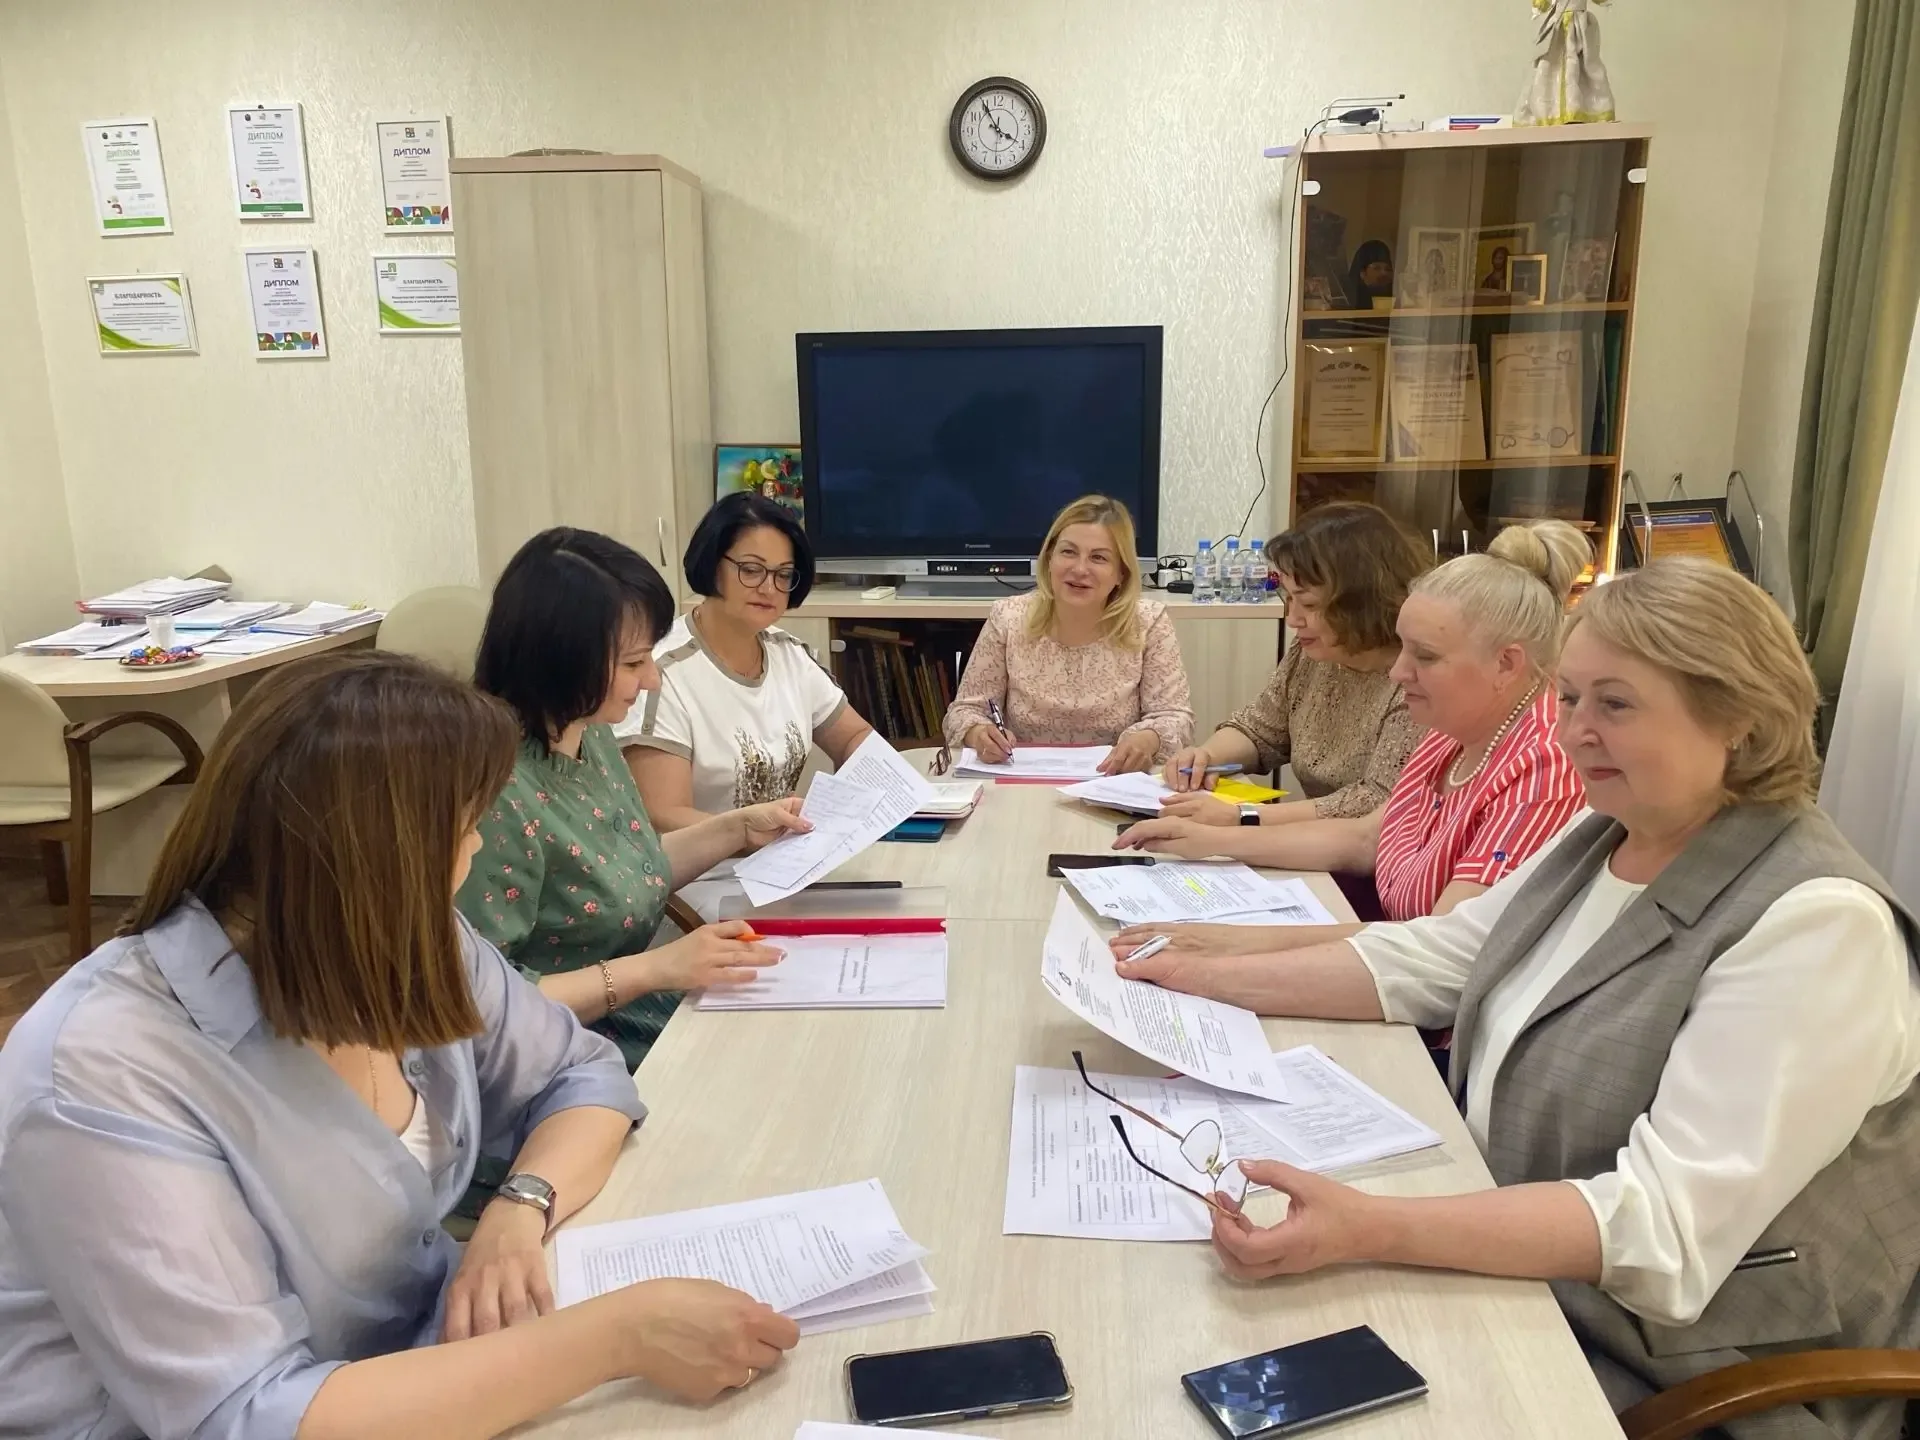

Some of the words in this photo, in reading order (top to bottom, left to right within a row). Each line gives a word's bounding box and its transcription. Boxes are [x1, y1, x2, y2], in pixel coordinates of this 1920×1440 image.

[966, 126, 974, 137] 9
[1023, 124, 1031, 136] 3
[247, 132, 284, 142] ДИПЛОМ
[971, 140, 978, 152] 8
[1018, 139, 1025, 151] 4
[106, 149, 141, 160] ДИПЛОМ
[393, 147, 431, 157] ДИПЛОМ
[982, 151, 988, 163] 7
[1009, 150, 1016, 162] 5
[994, 154, 1002, 166] 6
[263, 279, 300, 288] ДИПЛОМ
